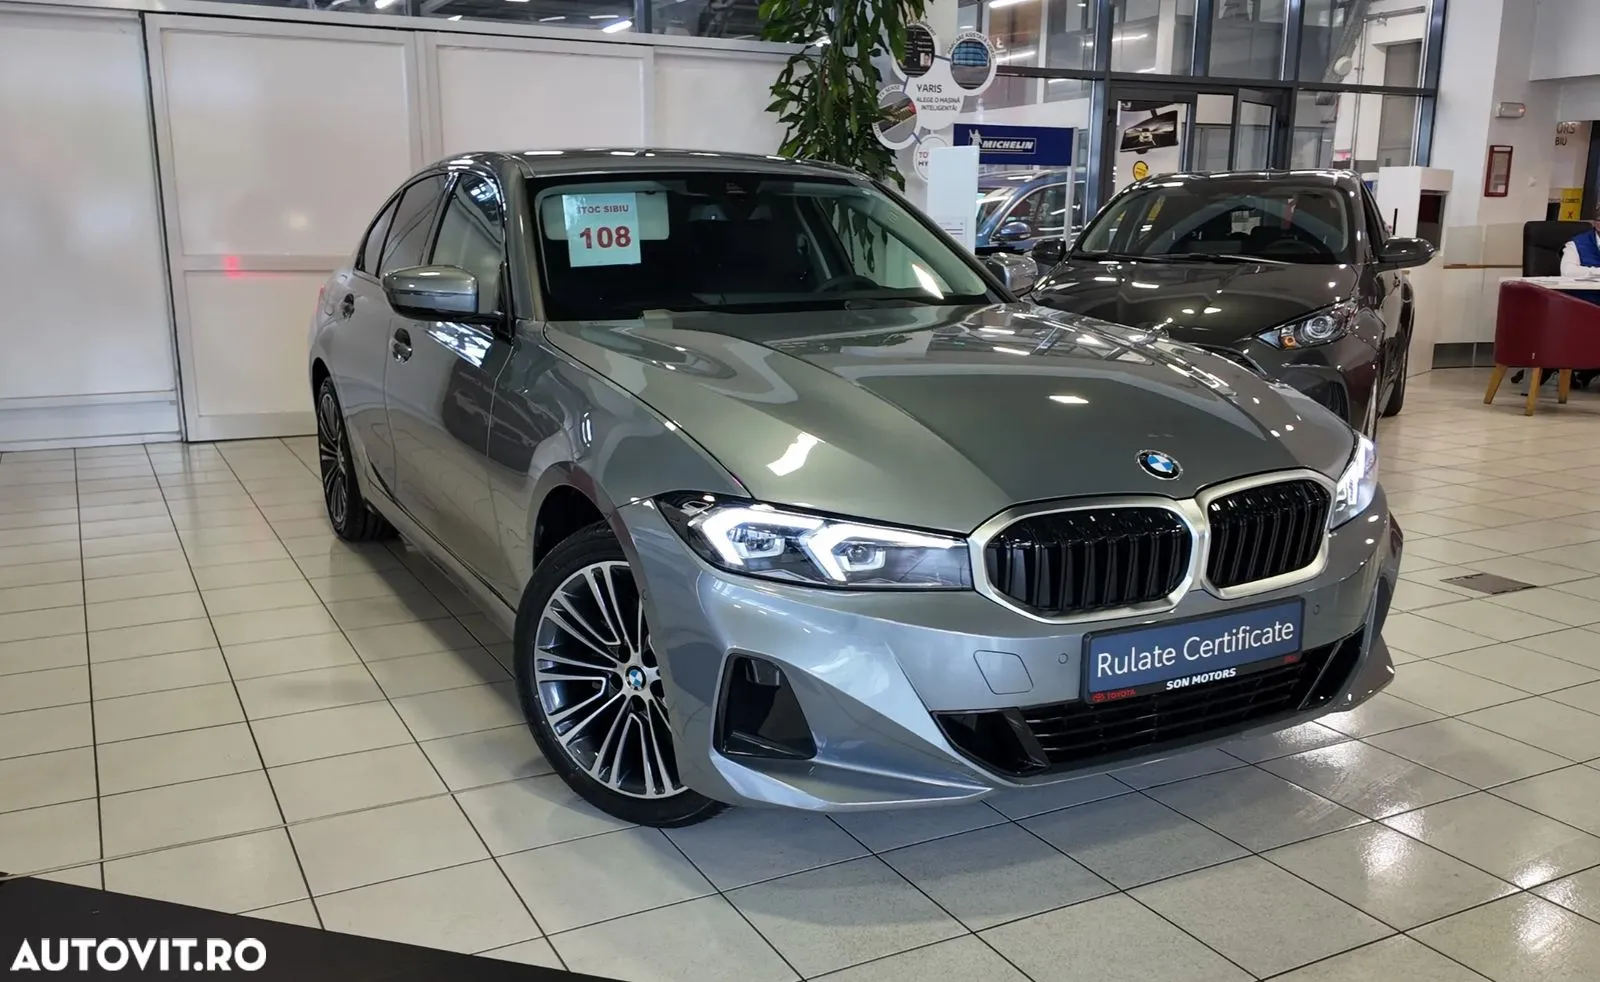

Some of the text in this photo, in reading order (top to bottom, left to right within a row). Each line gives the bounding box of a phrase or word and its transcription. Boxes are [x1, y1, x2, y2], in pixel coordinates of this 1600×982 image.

[916, 84, 943, 93] YARIS
[982, 140, 1034, 149] MICHELIN
[603, 205, 629, 213] SIBIU
[580, 226, 631, 249] 108
[1097, 620, 1294, 678] Rulate Certificate
[1166, 667, 1237, 690] SON MOTORS
